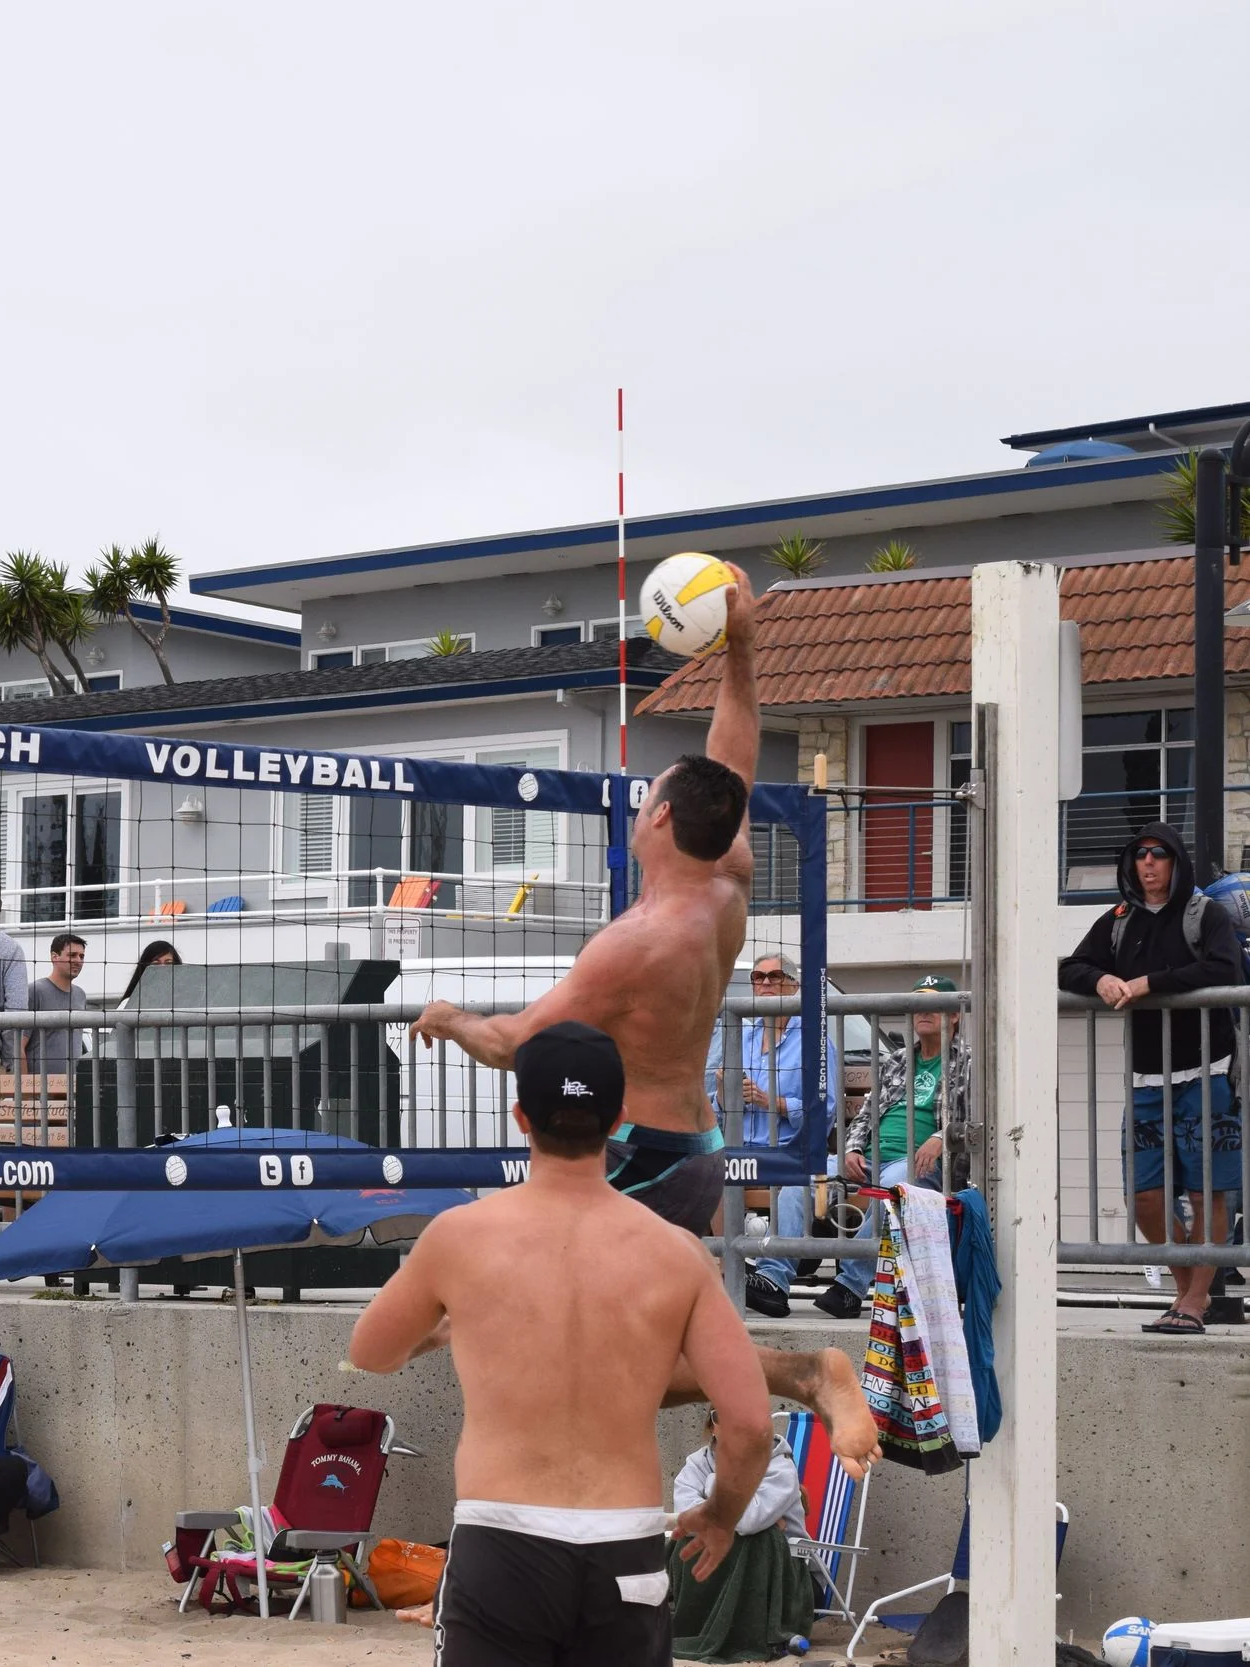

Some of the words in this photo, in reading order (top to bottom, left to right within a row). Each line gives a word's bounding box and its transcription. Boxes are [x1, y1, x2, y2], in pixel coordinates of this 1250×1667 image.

[652, 589, 685, 633] Wilson
[693, 628, 723, 654] Wilson
[145, 743, 415, 792] VOLLEYBALL
[311, 1453, 338, 1468] TOMMY
[338, 1454, 362, 1476] BAHAMA
